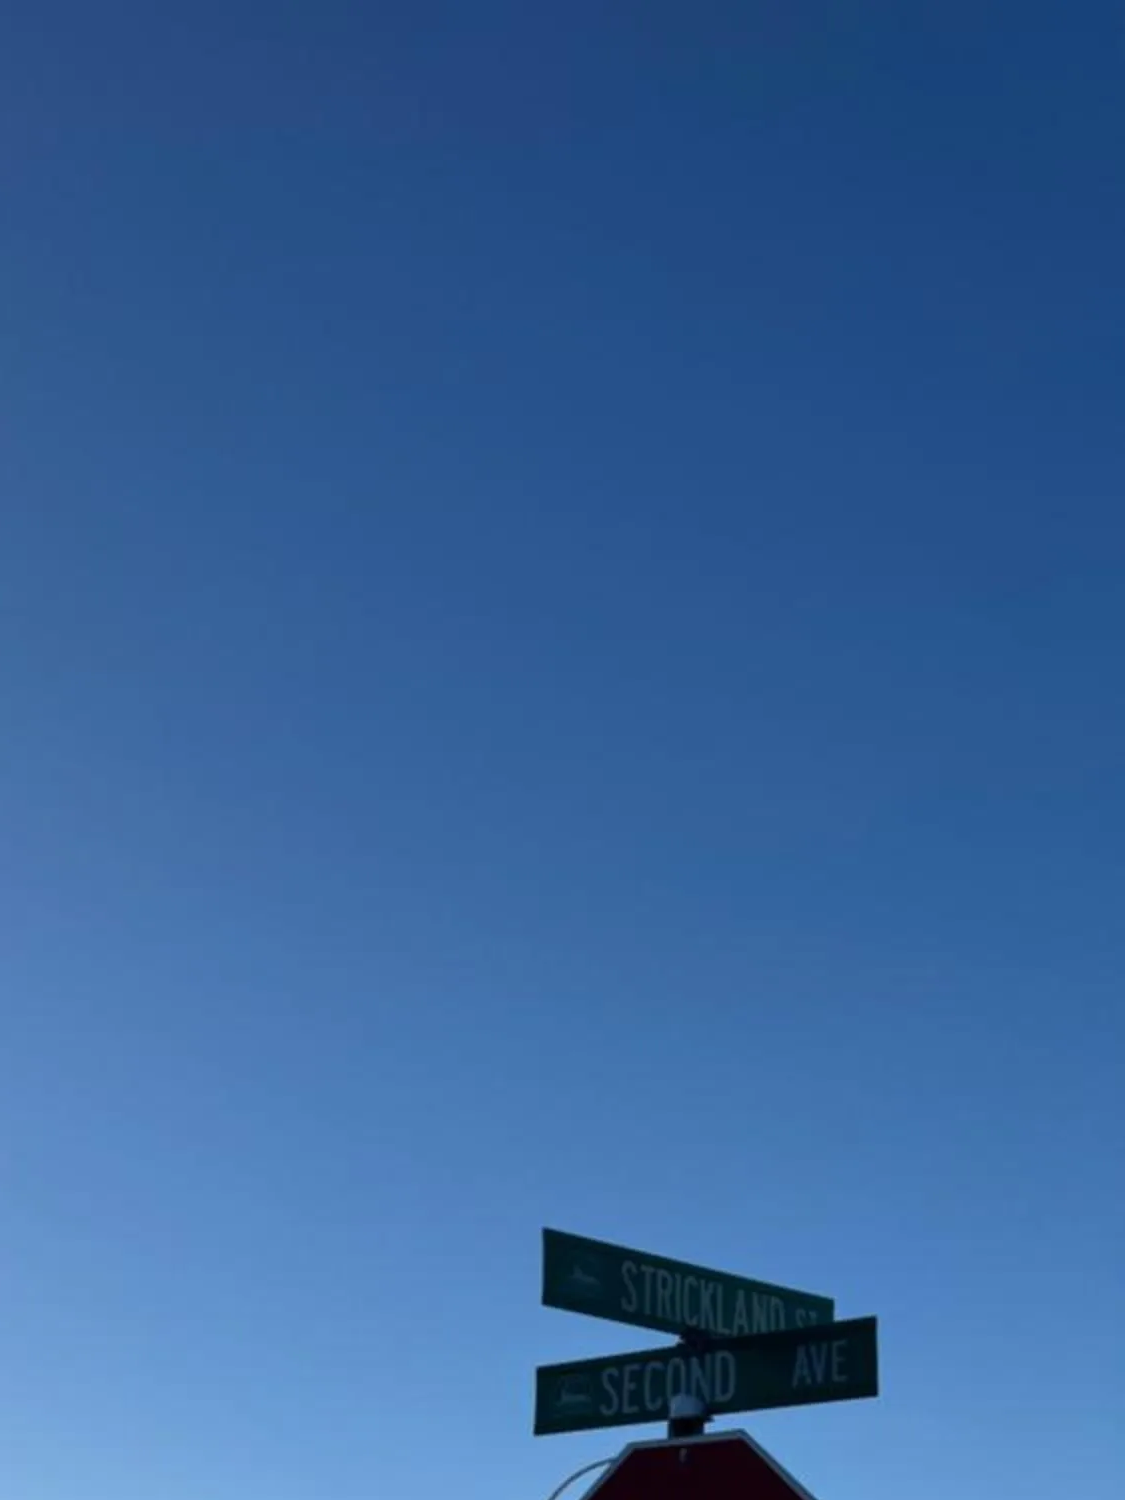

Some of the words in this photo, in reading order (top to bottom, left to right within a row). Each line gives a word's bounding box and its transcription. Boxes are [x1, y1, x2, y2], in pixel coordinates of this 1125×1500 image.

[620, 1260, 786, 1337] STRICKLAND
[599, 1350, 737, 1417] SECOND
[791, 1339, 849, 1389] AVE
